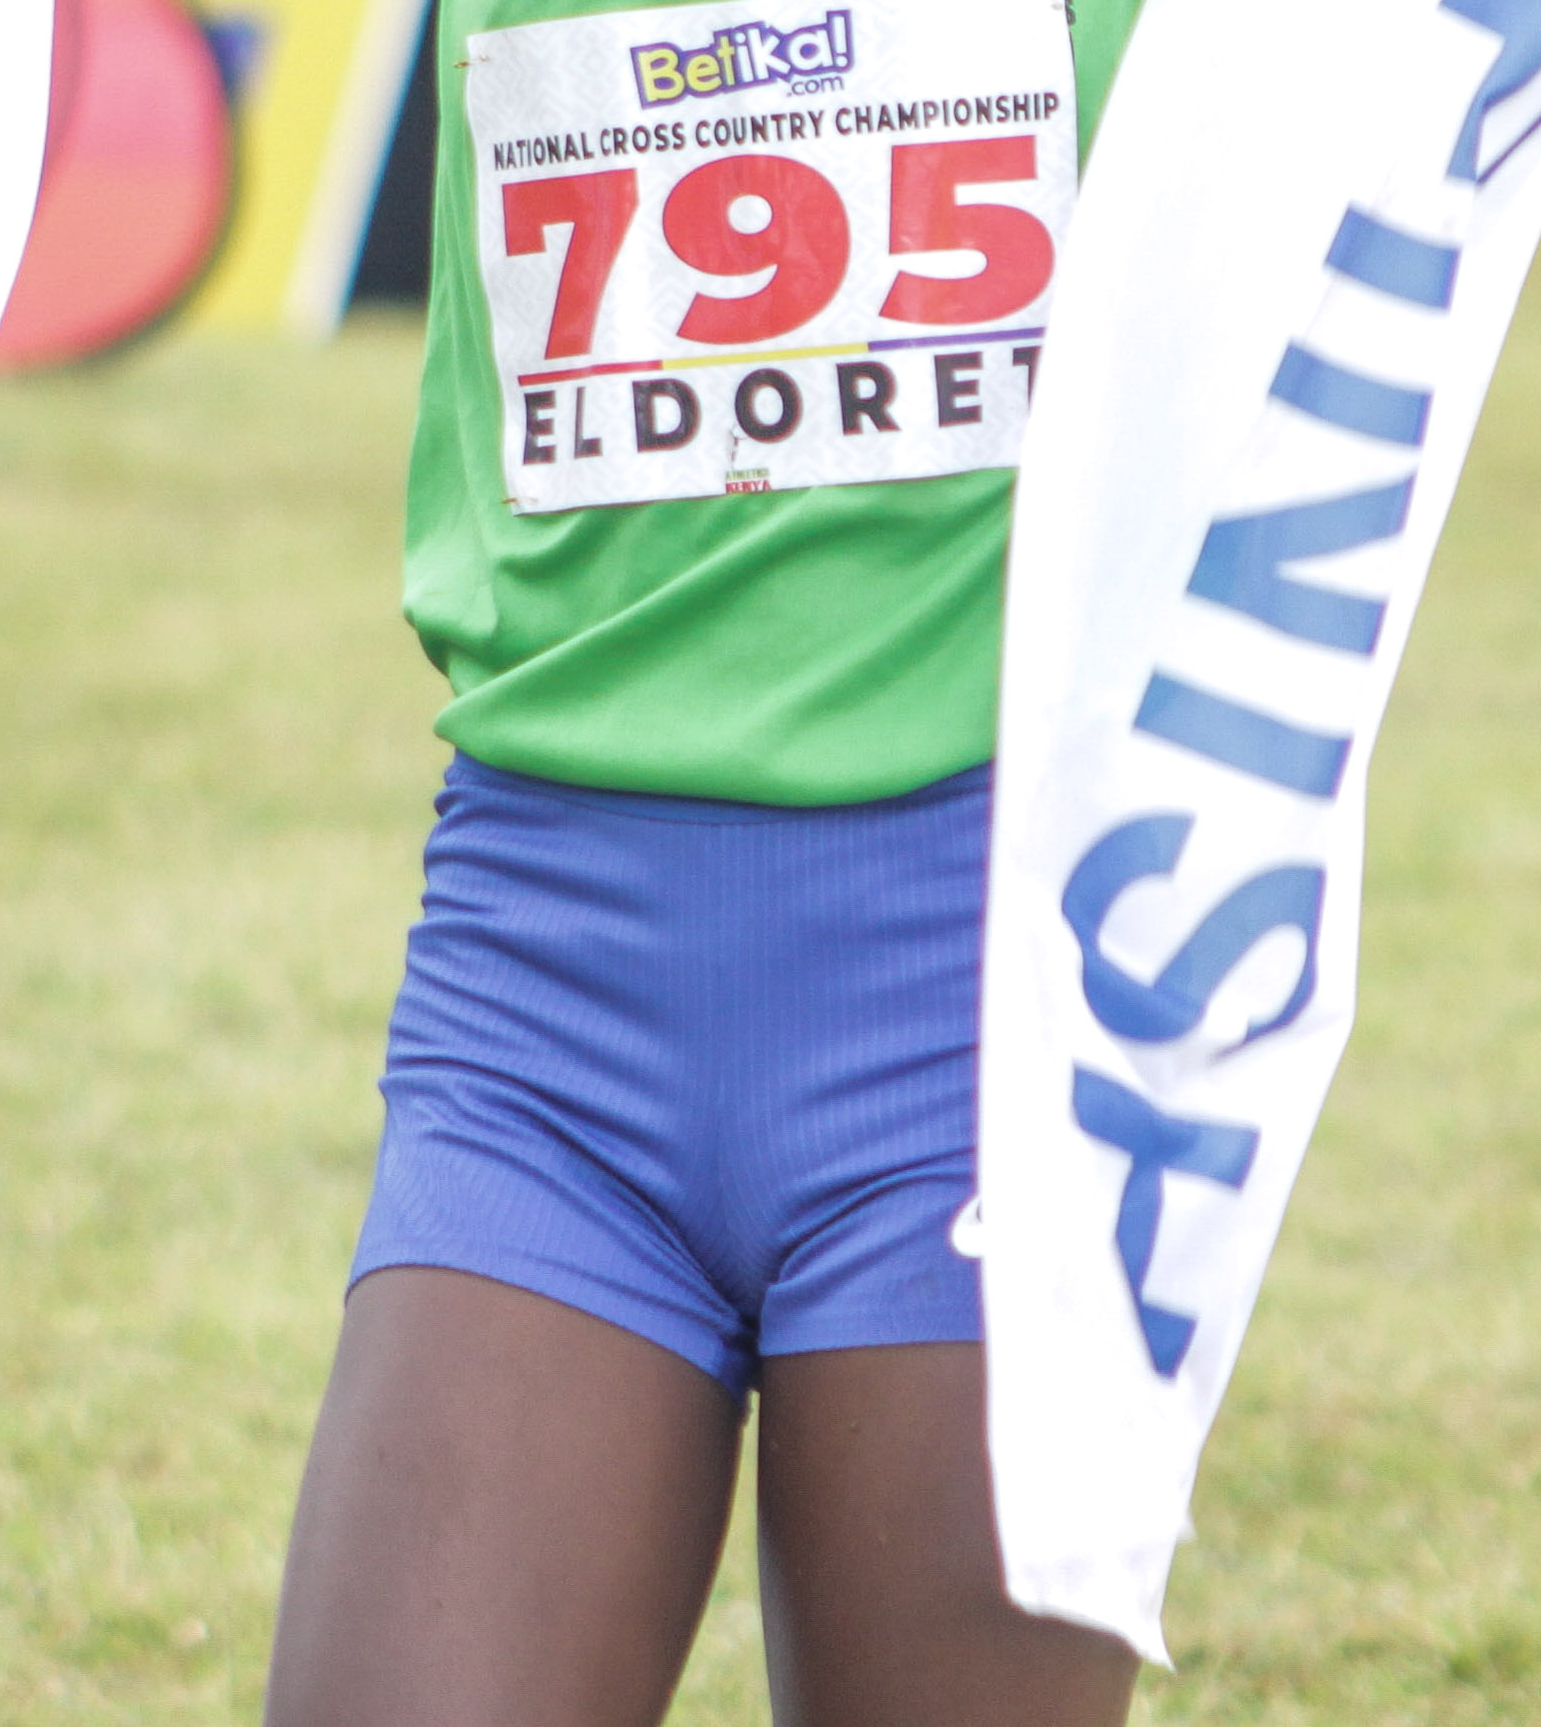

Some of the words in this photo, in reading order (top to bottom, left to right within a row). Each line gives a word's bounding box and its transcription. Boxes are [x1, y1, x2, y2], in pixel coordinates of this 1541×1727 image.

[631, 10, 854, 110] Betika!
[786, 75, 845, 97] .com
[493, 130, 596, 171] NATIONAL
[599, 120, 687, 158] CROSS
[694, 108, 826, 149] COUNTRY
[834, 90, 1060, 137] CHAMPIONSHIP
[502, 134, 1057, 361] 795
